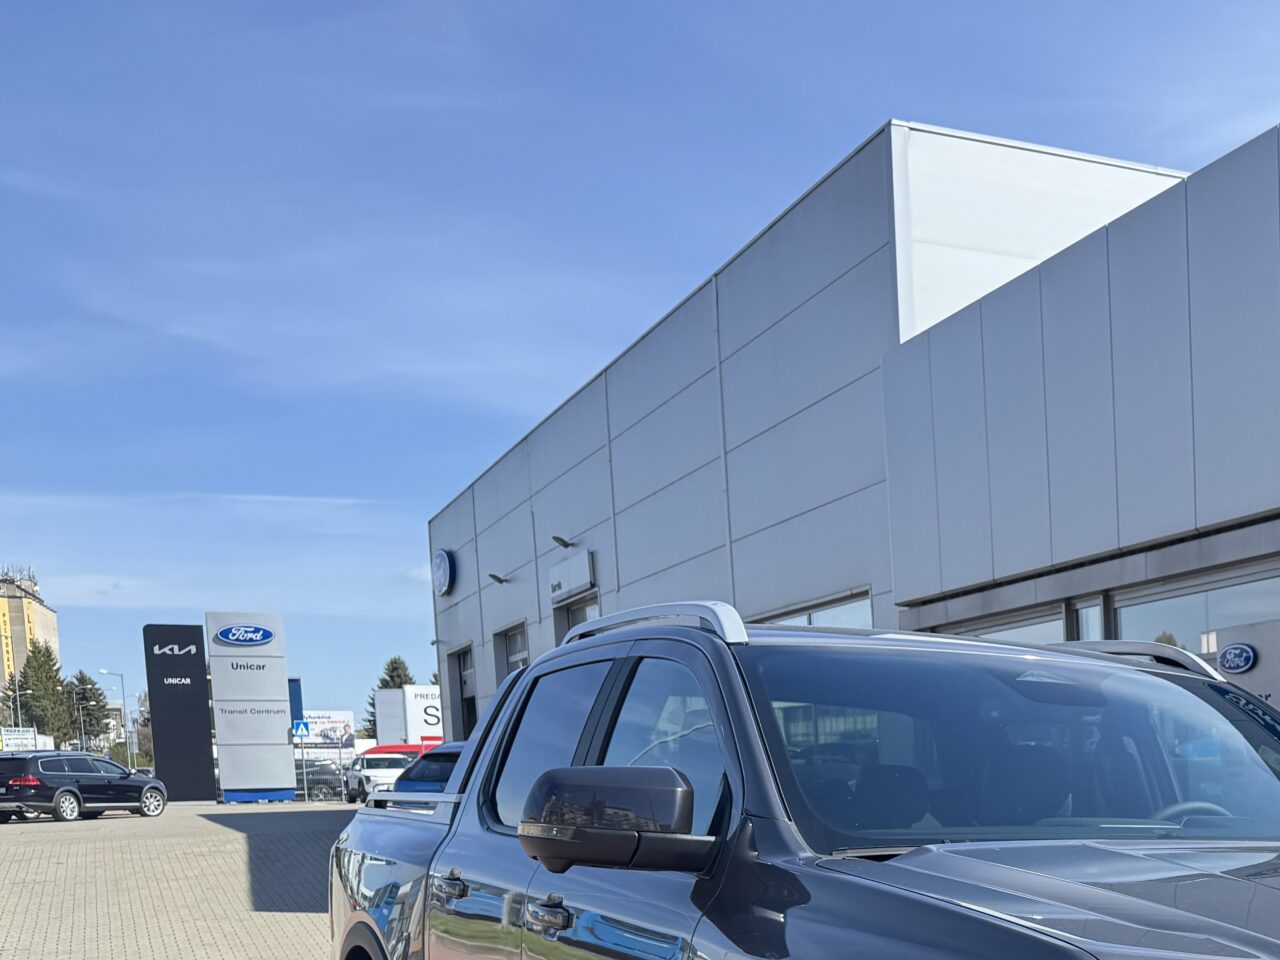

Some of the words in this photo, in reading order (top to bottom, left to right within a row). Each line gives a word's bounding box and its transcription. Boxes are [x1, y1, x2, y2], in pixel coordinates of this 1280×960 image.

[228, 625, 264, 641] Ford
[1223, 648, 1248, 669] Ford
[231, 661, 267, 671] Unicar
[163, 677, 191, 685] UNICAR
[219, 707, 248, 715] Transit
[249, 707, 286, 715] Centrum
